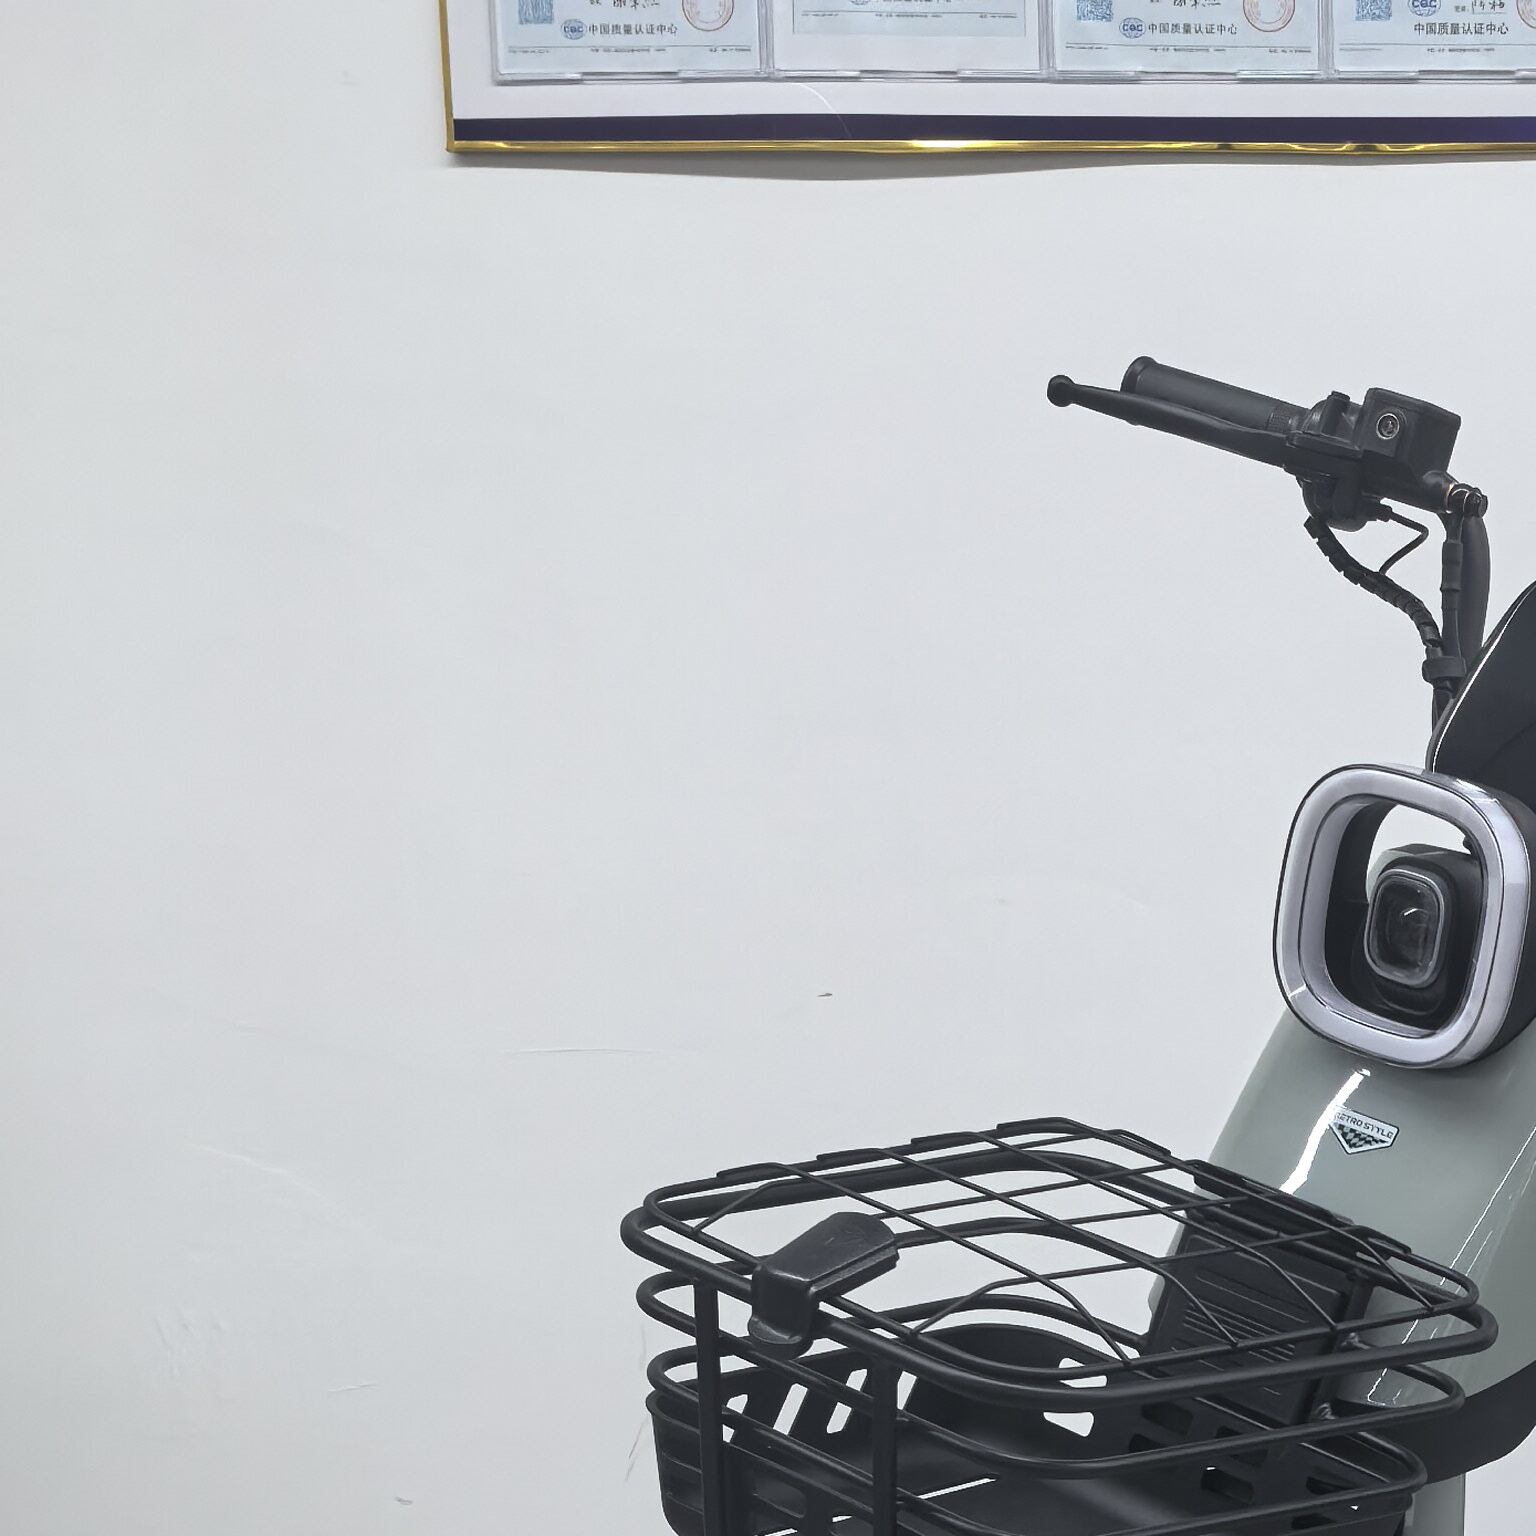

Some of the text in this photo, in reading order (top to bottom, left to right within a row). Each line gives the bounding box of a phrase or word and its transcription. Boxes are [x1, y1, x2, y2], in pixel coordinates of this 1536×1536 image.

[588, 23, 678, 35] 中国质量认证中心
[1148, 23, 1237, 35] 中国质量认证中心
[1413, 22, 1509, 35] 中国质量认证中心
